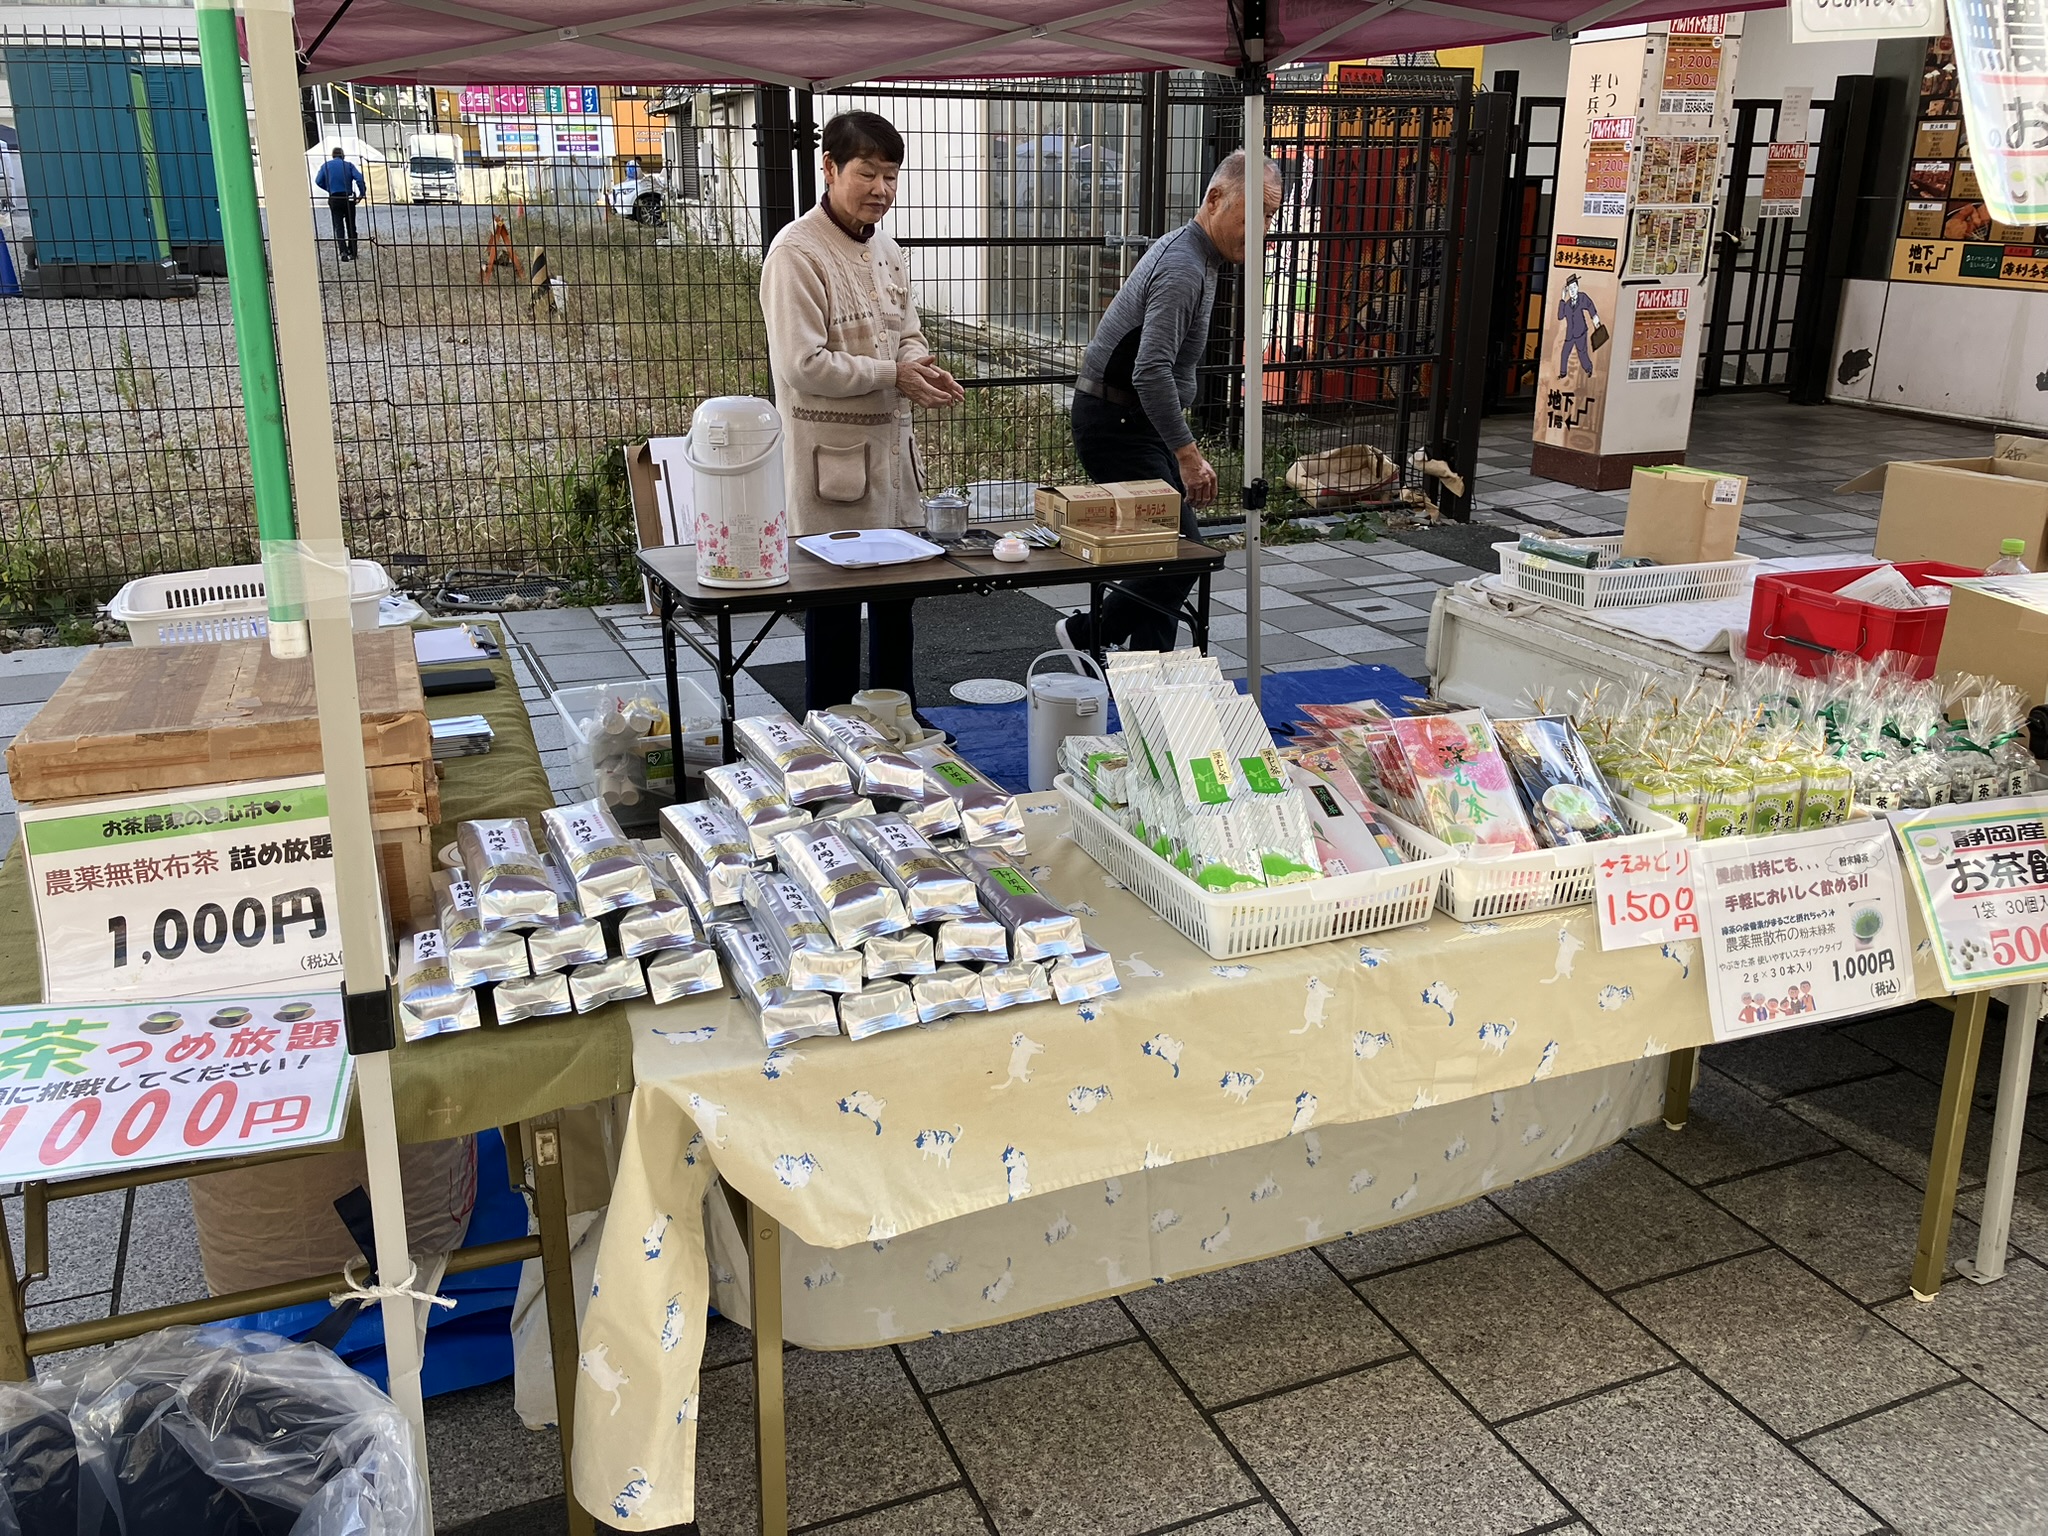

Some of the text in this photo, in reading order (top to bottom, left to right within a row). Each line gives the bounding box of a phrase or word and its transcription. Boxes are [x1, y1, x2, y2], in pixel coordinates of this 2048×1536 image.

[584, 88, 595, 112] パイプ
[1604, 73, 1619, 118] いつ
[1909, 244, 1935, 261] 地下
[1908, 261, 1923, 274] 1階
[1547, 389, 1575, 412] 地下
[1547, 411, 1563, 428] 1階
[767, 725, 793, 743] 静岡茶
[733, 770, 758, 790] 静岡茶
[1439, 743, 1499, 824] 深むし茶
[1978, 784, 1991, 798] 茶
[1783, 800, 1796, 829] 粉末
[1875, 797, 1888, 810] 茶
[102, 799, 264, 838] お茶農家の良心市
[570, 818, 597, 844] 静岡茶
[485, 828, 511, 852] 静岡茶
[882, 825, 914, 848] 静岡茶
[1950, 822, 2048, 848] 静岡産
[45, 833, 334, 897] 農薬無散布茶 詰め放題
[810, 840, 841, 869] 静岡茶
[1838, 852, 1869, 867] 粉末緑茶
[454, 882, 477, 907] 静岡茶
[780, 885, 809, 910] 静岡茶
[1724, 873, 1869, 913] 手軽においしく飲める!!
[1971, 901, 1998, 920] 1袋
[108, 886, 328, 969] 1,000円
[1726, 923, 1837, 953] 農薬無散布の粉末緑茶
[418, 931, 438, 958] 静岡茶
[1718, 940, 1843, 972] やぶきた茶 使いやすいスティックタイプ
[1832, 948, 1896, 982] 1,000円
[1870, 977, 1901, 997] (税込)
[0, 1018, 342, 1080] 茶 つめ放題
